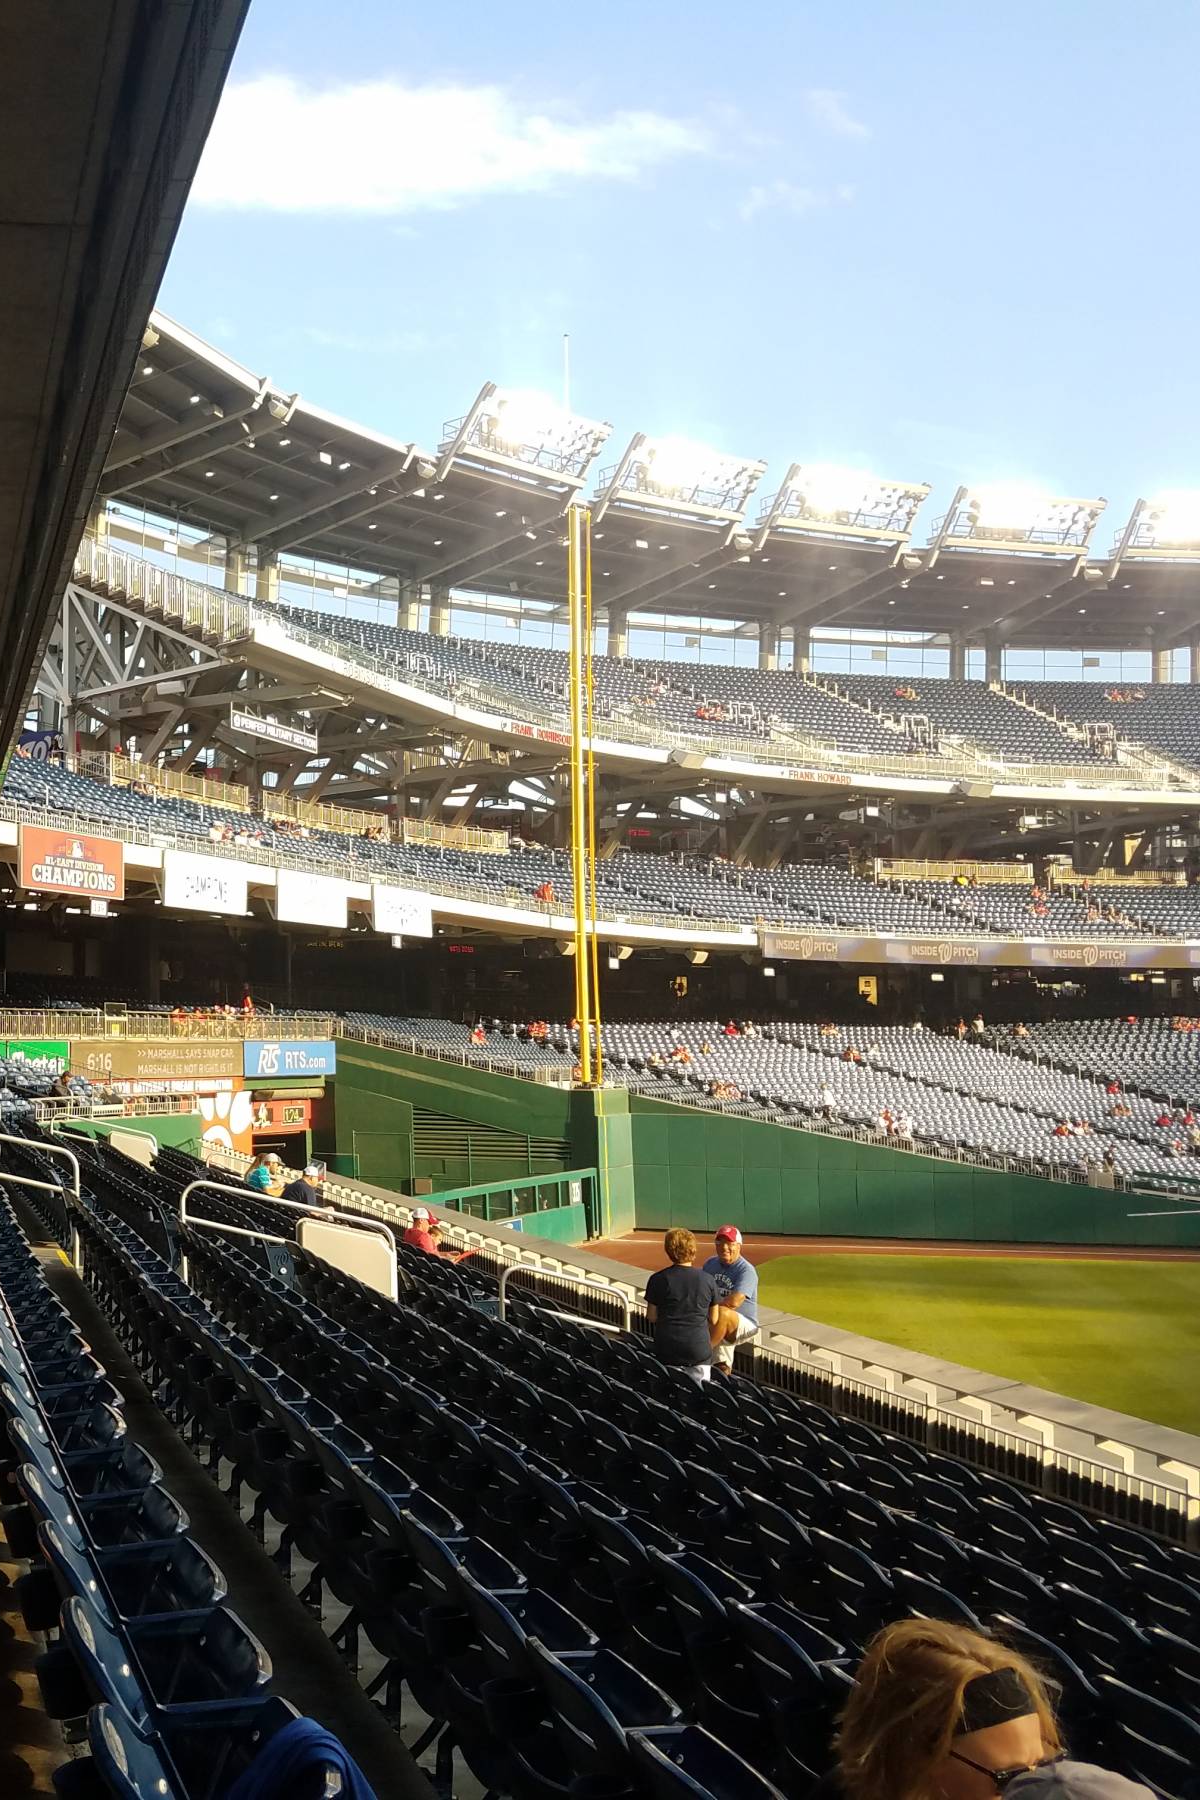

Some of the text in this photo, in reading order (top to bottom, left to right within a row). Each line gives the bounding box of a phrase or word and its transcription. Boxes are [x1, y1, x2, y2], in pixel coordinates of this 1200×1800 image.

[511, 721, 534, 738] FRANK
[789, 769, 852, 785] FRANK HOWARD
[31, 864, 116, 892] CHAMPIONS
[776, 938, 800, 951] INSIDE
[814, 941, 838, 953] PITCH
[912, 944, 938, 956] INSIDE
[953, 946, 978, 957] PITCH
[1053, 949, 1082, 960] INSIDE
[1099, 950, 1127, 960] PITCH
[147, 1048, 184, 1058] MARSHALL
[185, 1048, 202, 1058] SAYS
[257, 1043, 281, 1074] RTS
[285, 1050, 326, 1069] RTS.com
[87, 1052, 112, 1071] 6:16
[137, 1064, 175, 1074] MARSHALL
[184, 1063, 198, 1073] NOT
[284, 1108, 300, 1123] 124
